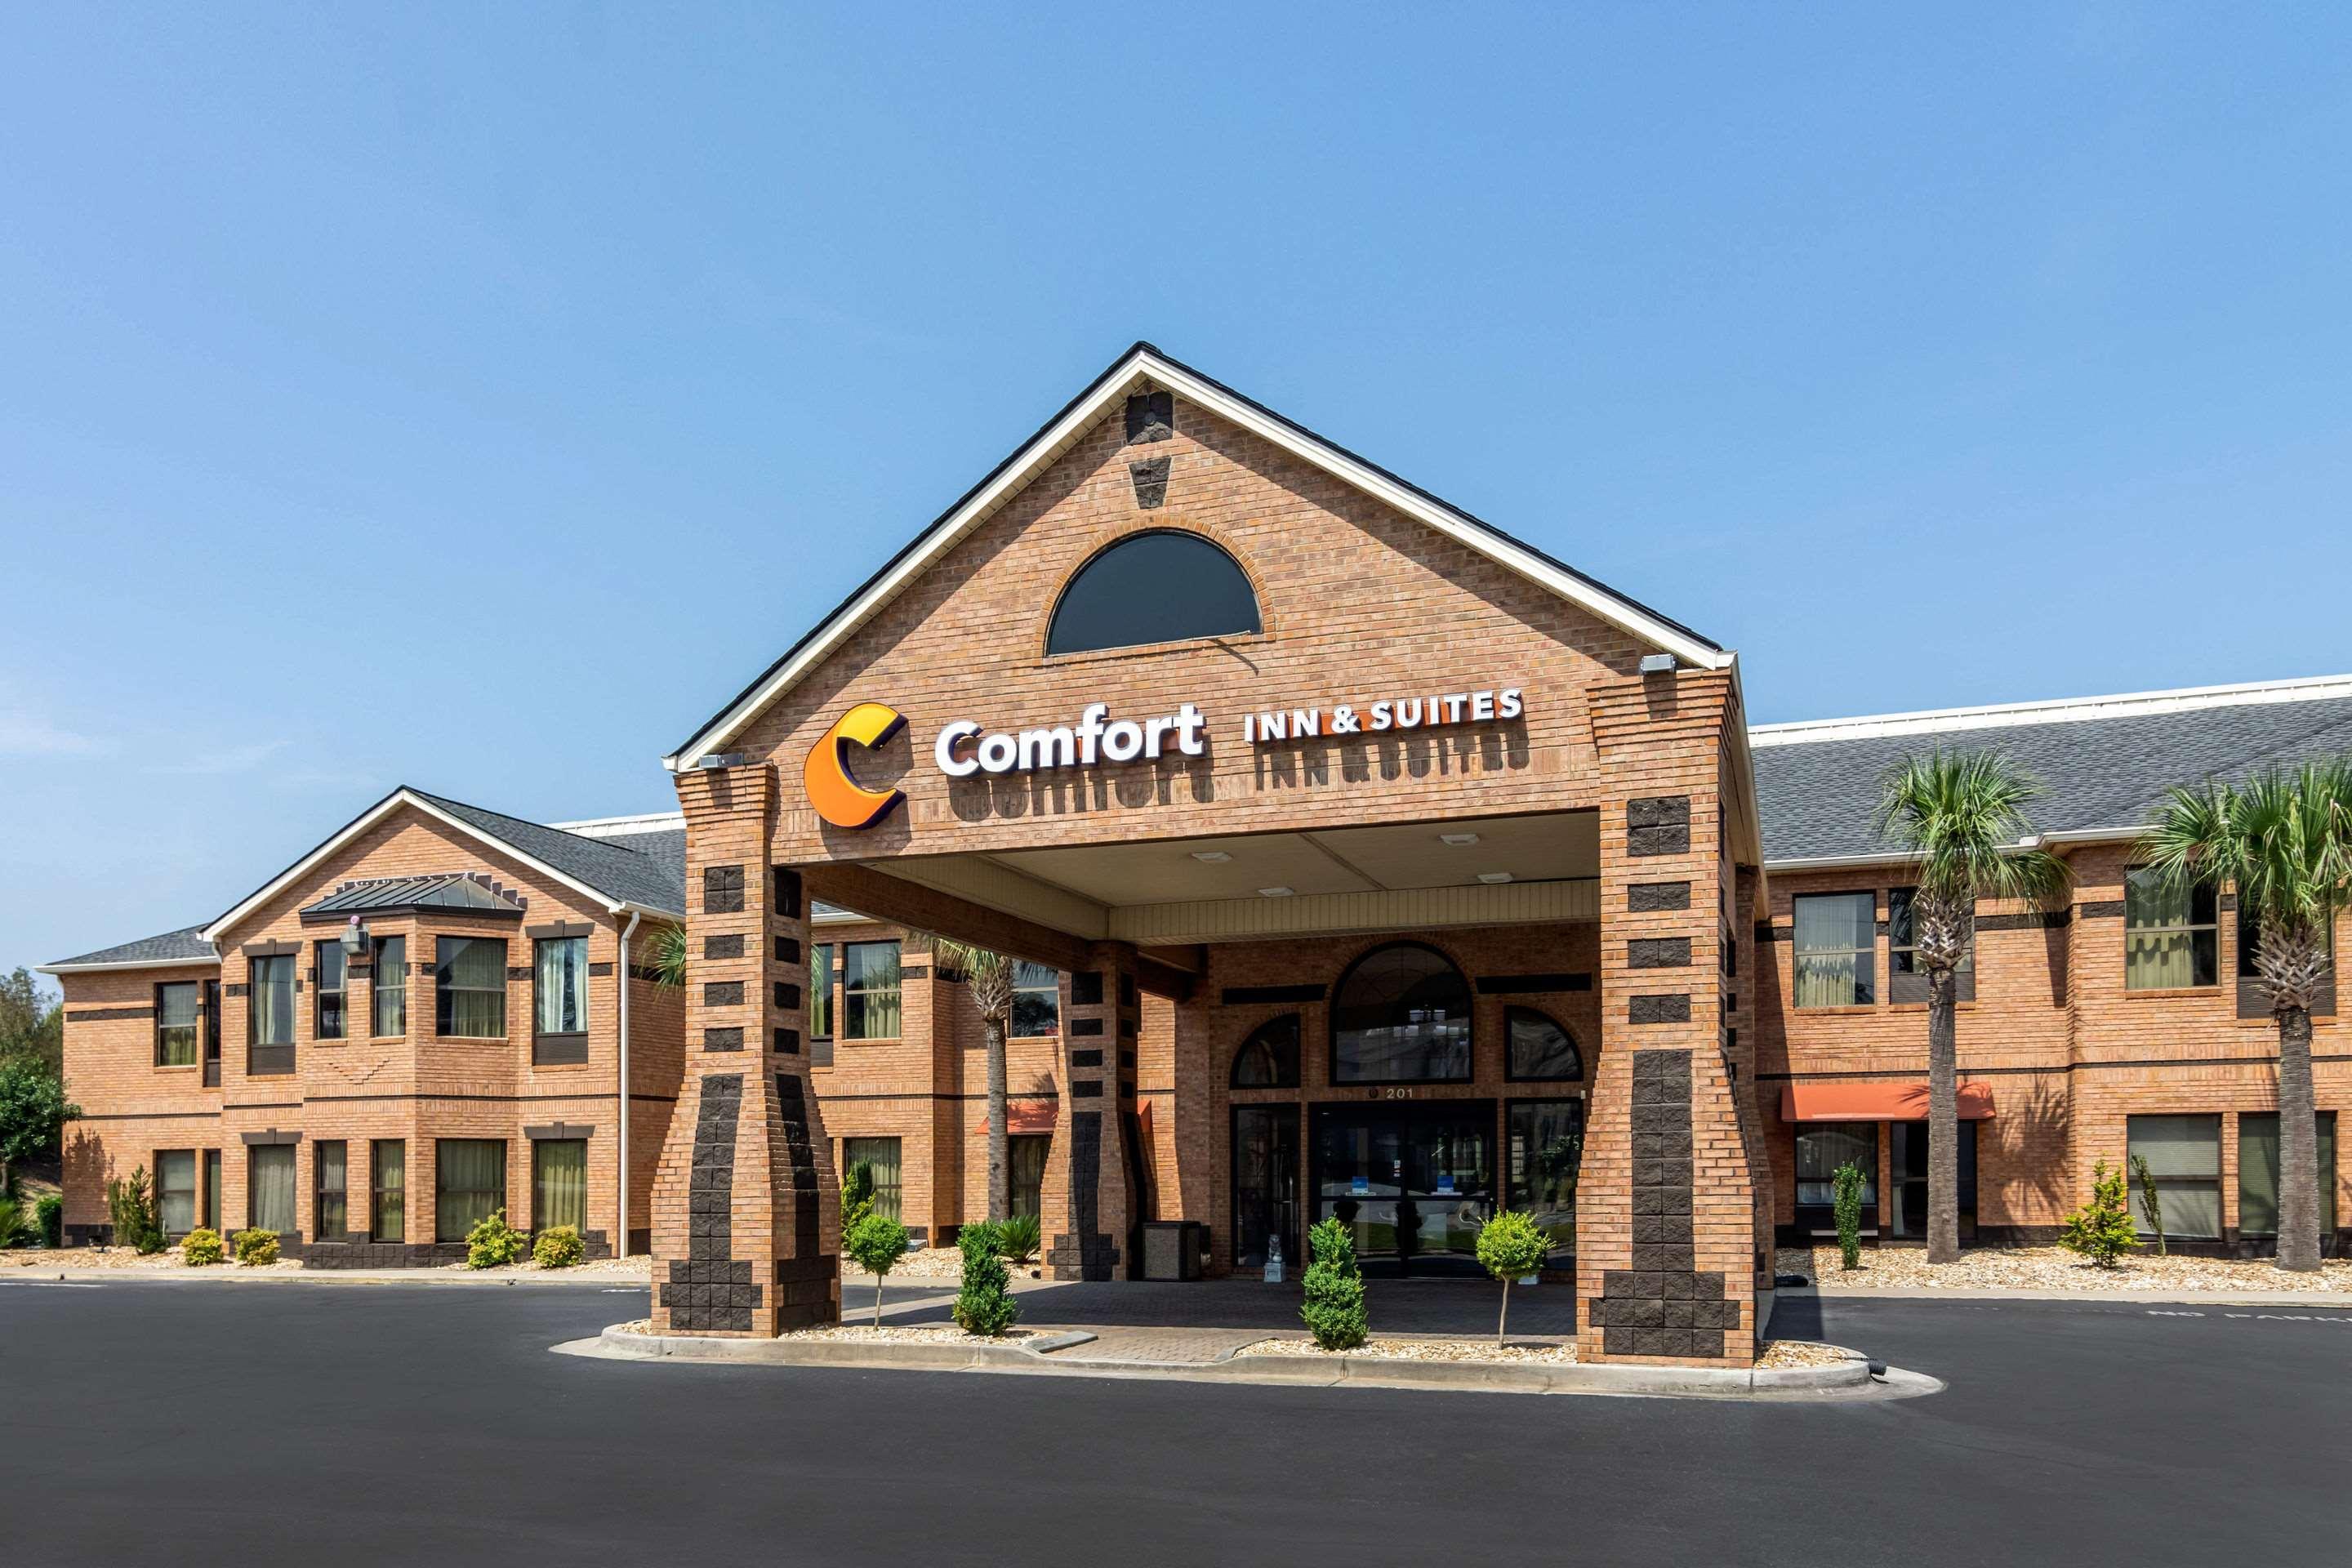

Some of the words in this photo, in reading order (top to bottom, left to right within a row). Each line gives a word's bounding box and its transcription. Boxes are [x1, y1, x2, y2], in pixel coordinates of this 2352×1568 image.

[935, 703, 1205, 776] Comfort
[1244, 709, 1320, 742] INN
[1331, 704, 1361, 733] &
[1370, 688, 1522, 730] SUITES
[1387, 1088, 1414, 1098] 201
